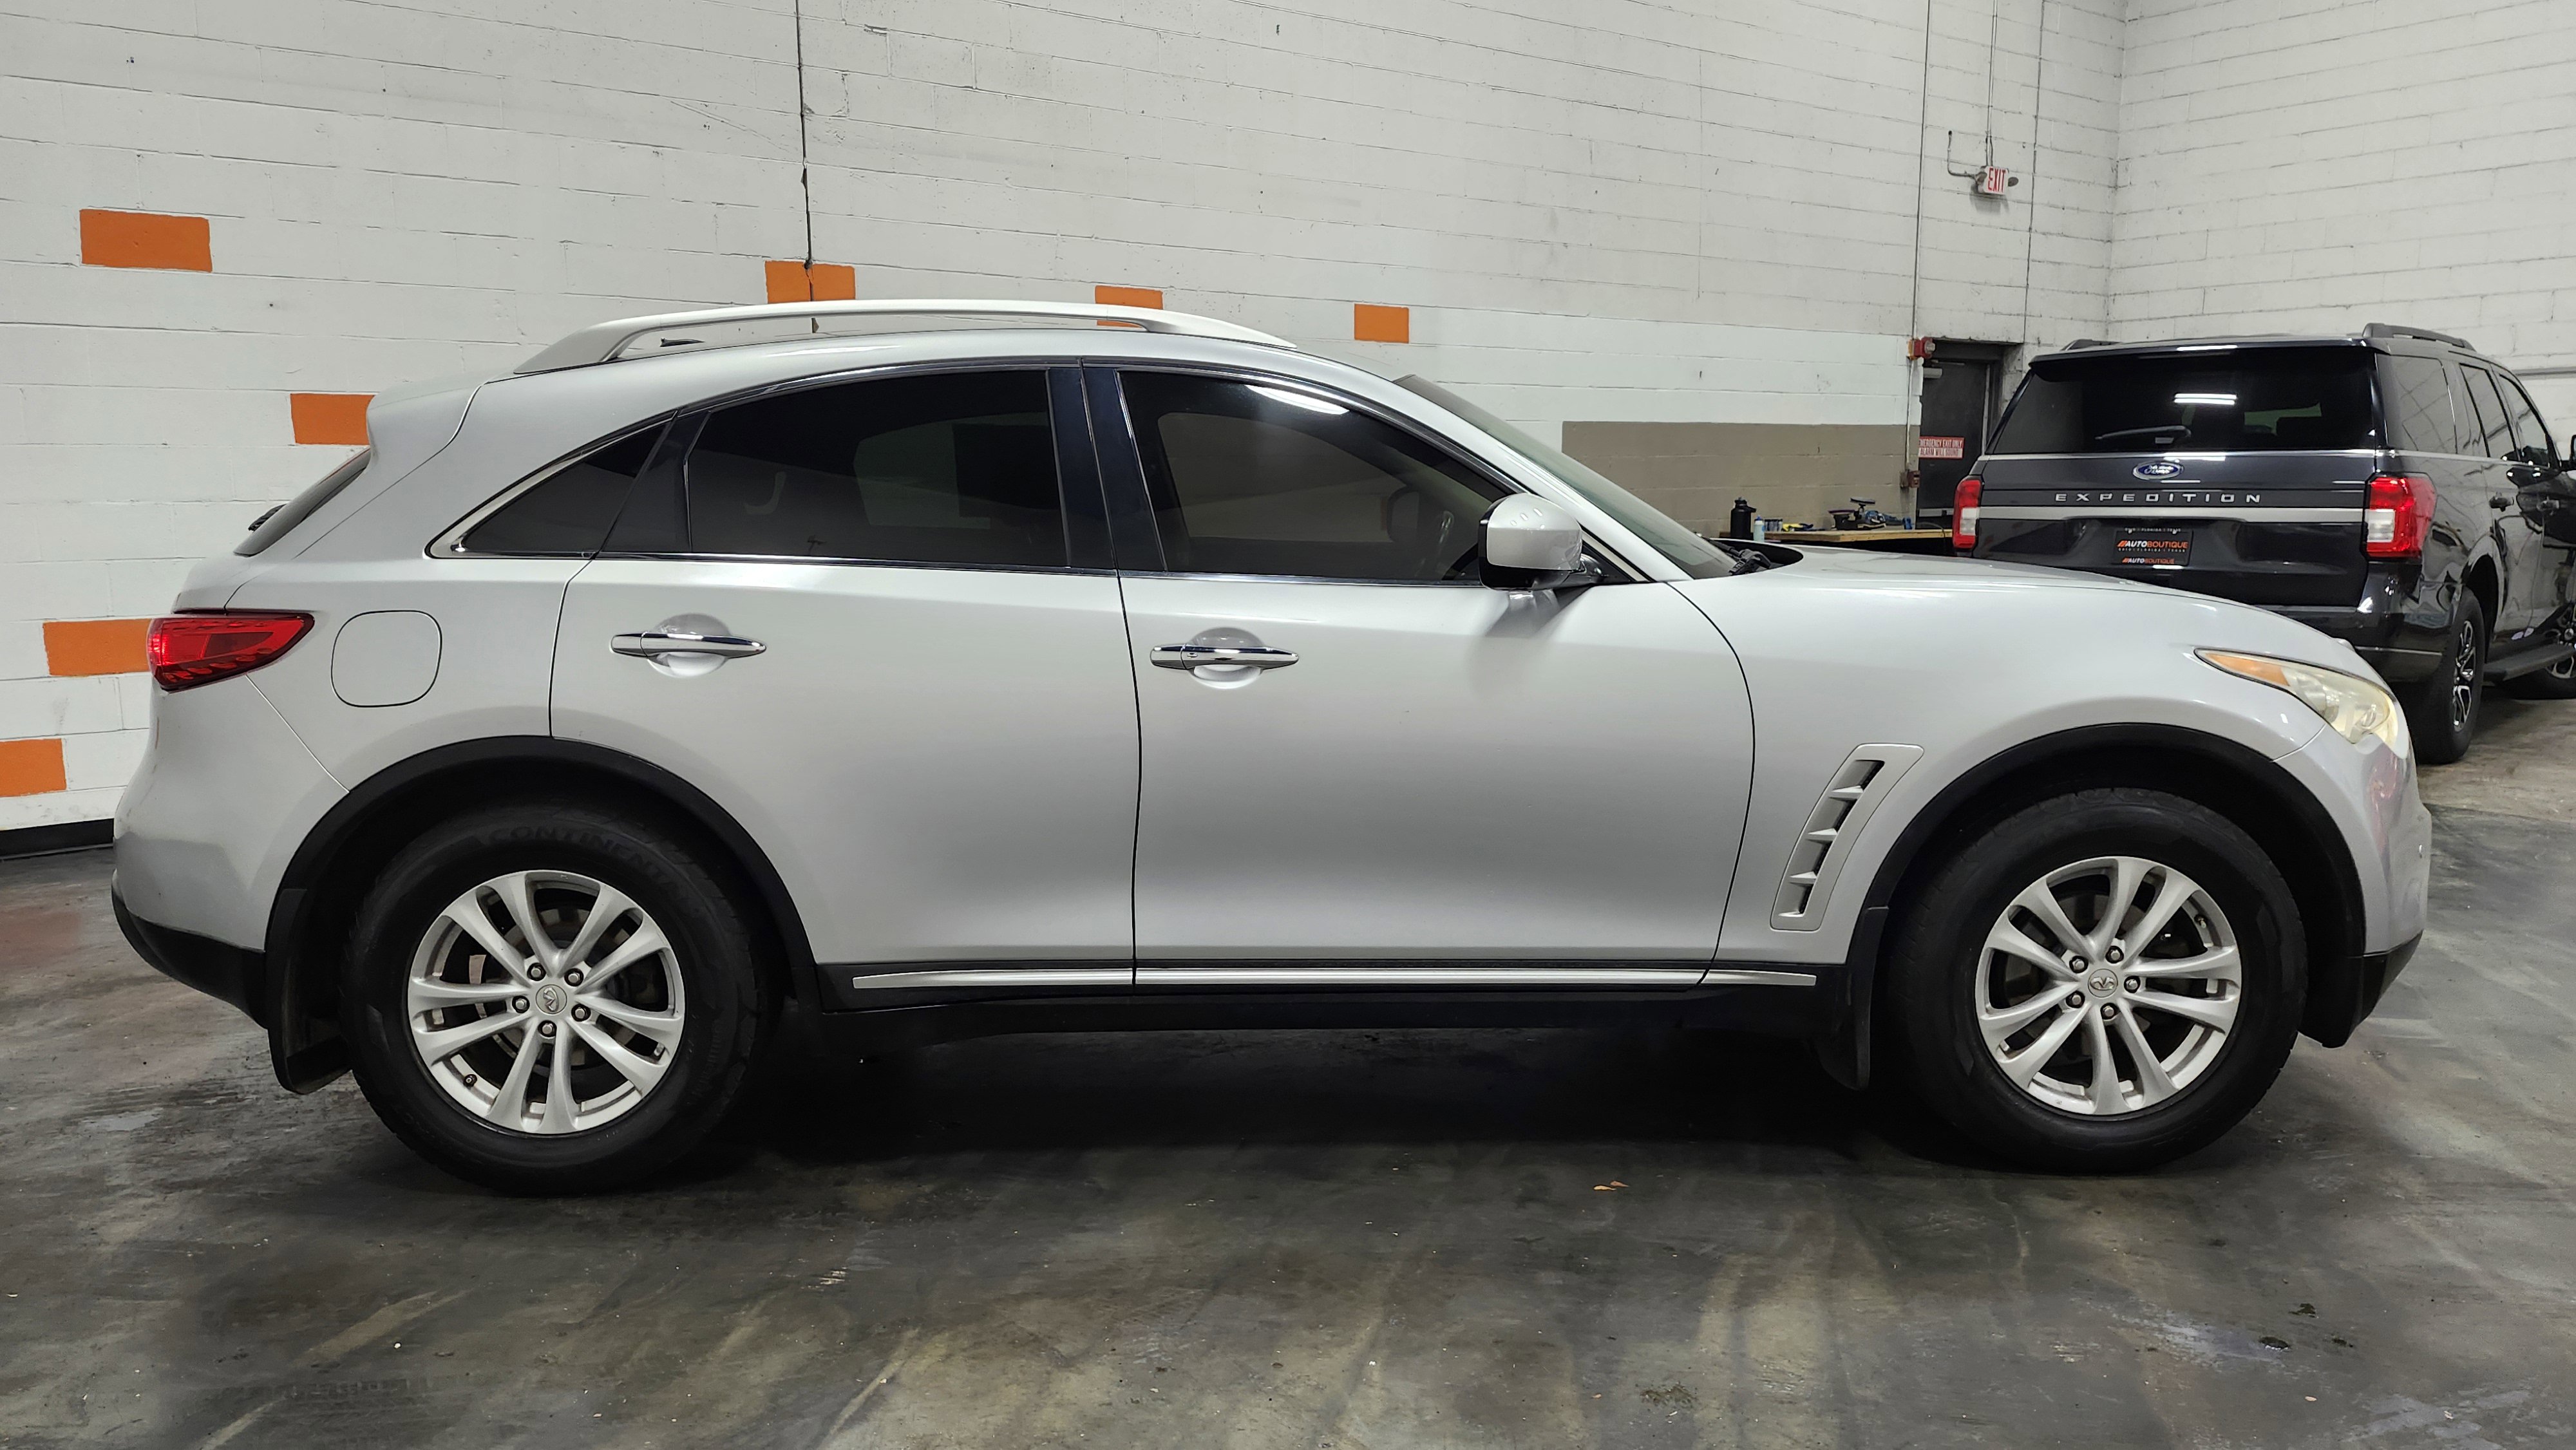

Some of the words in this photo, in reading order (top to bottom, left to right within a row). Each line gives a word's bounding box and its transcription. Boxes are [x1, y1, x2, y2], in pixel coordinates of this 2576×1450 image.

[1988, 167, 2005, 193] EXIT
[2055, 493, 2260, 503] EXPEDITION
[2124, 540, 2188, 549] AUTOBOUTIQUE
